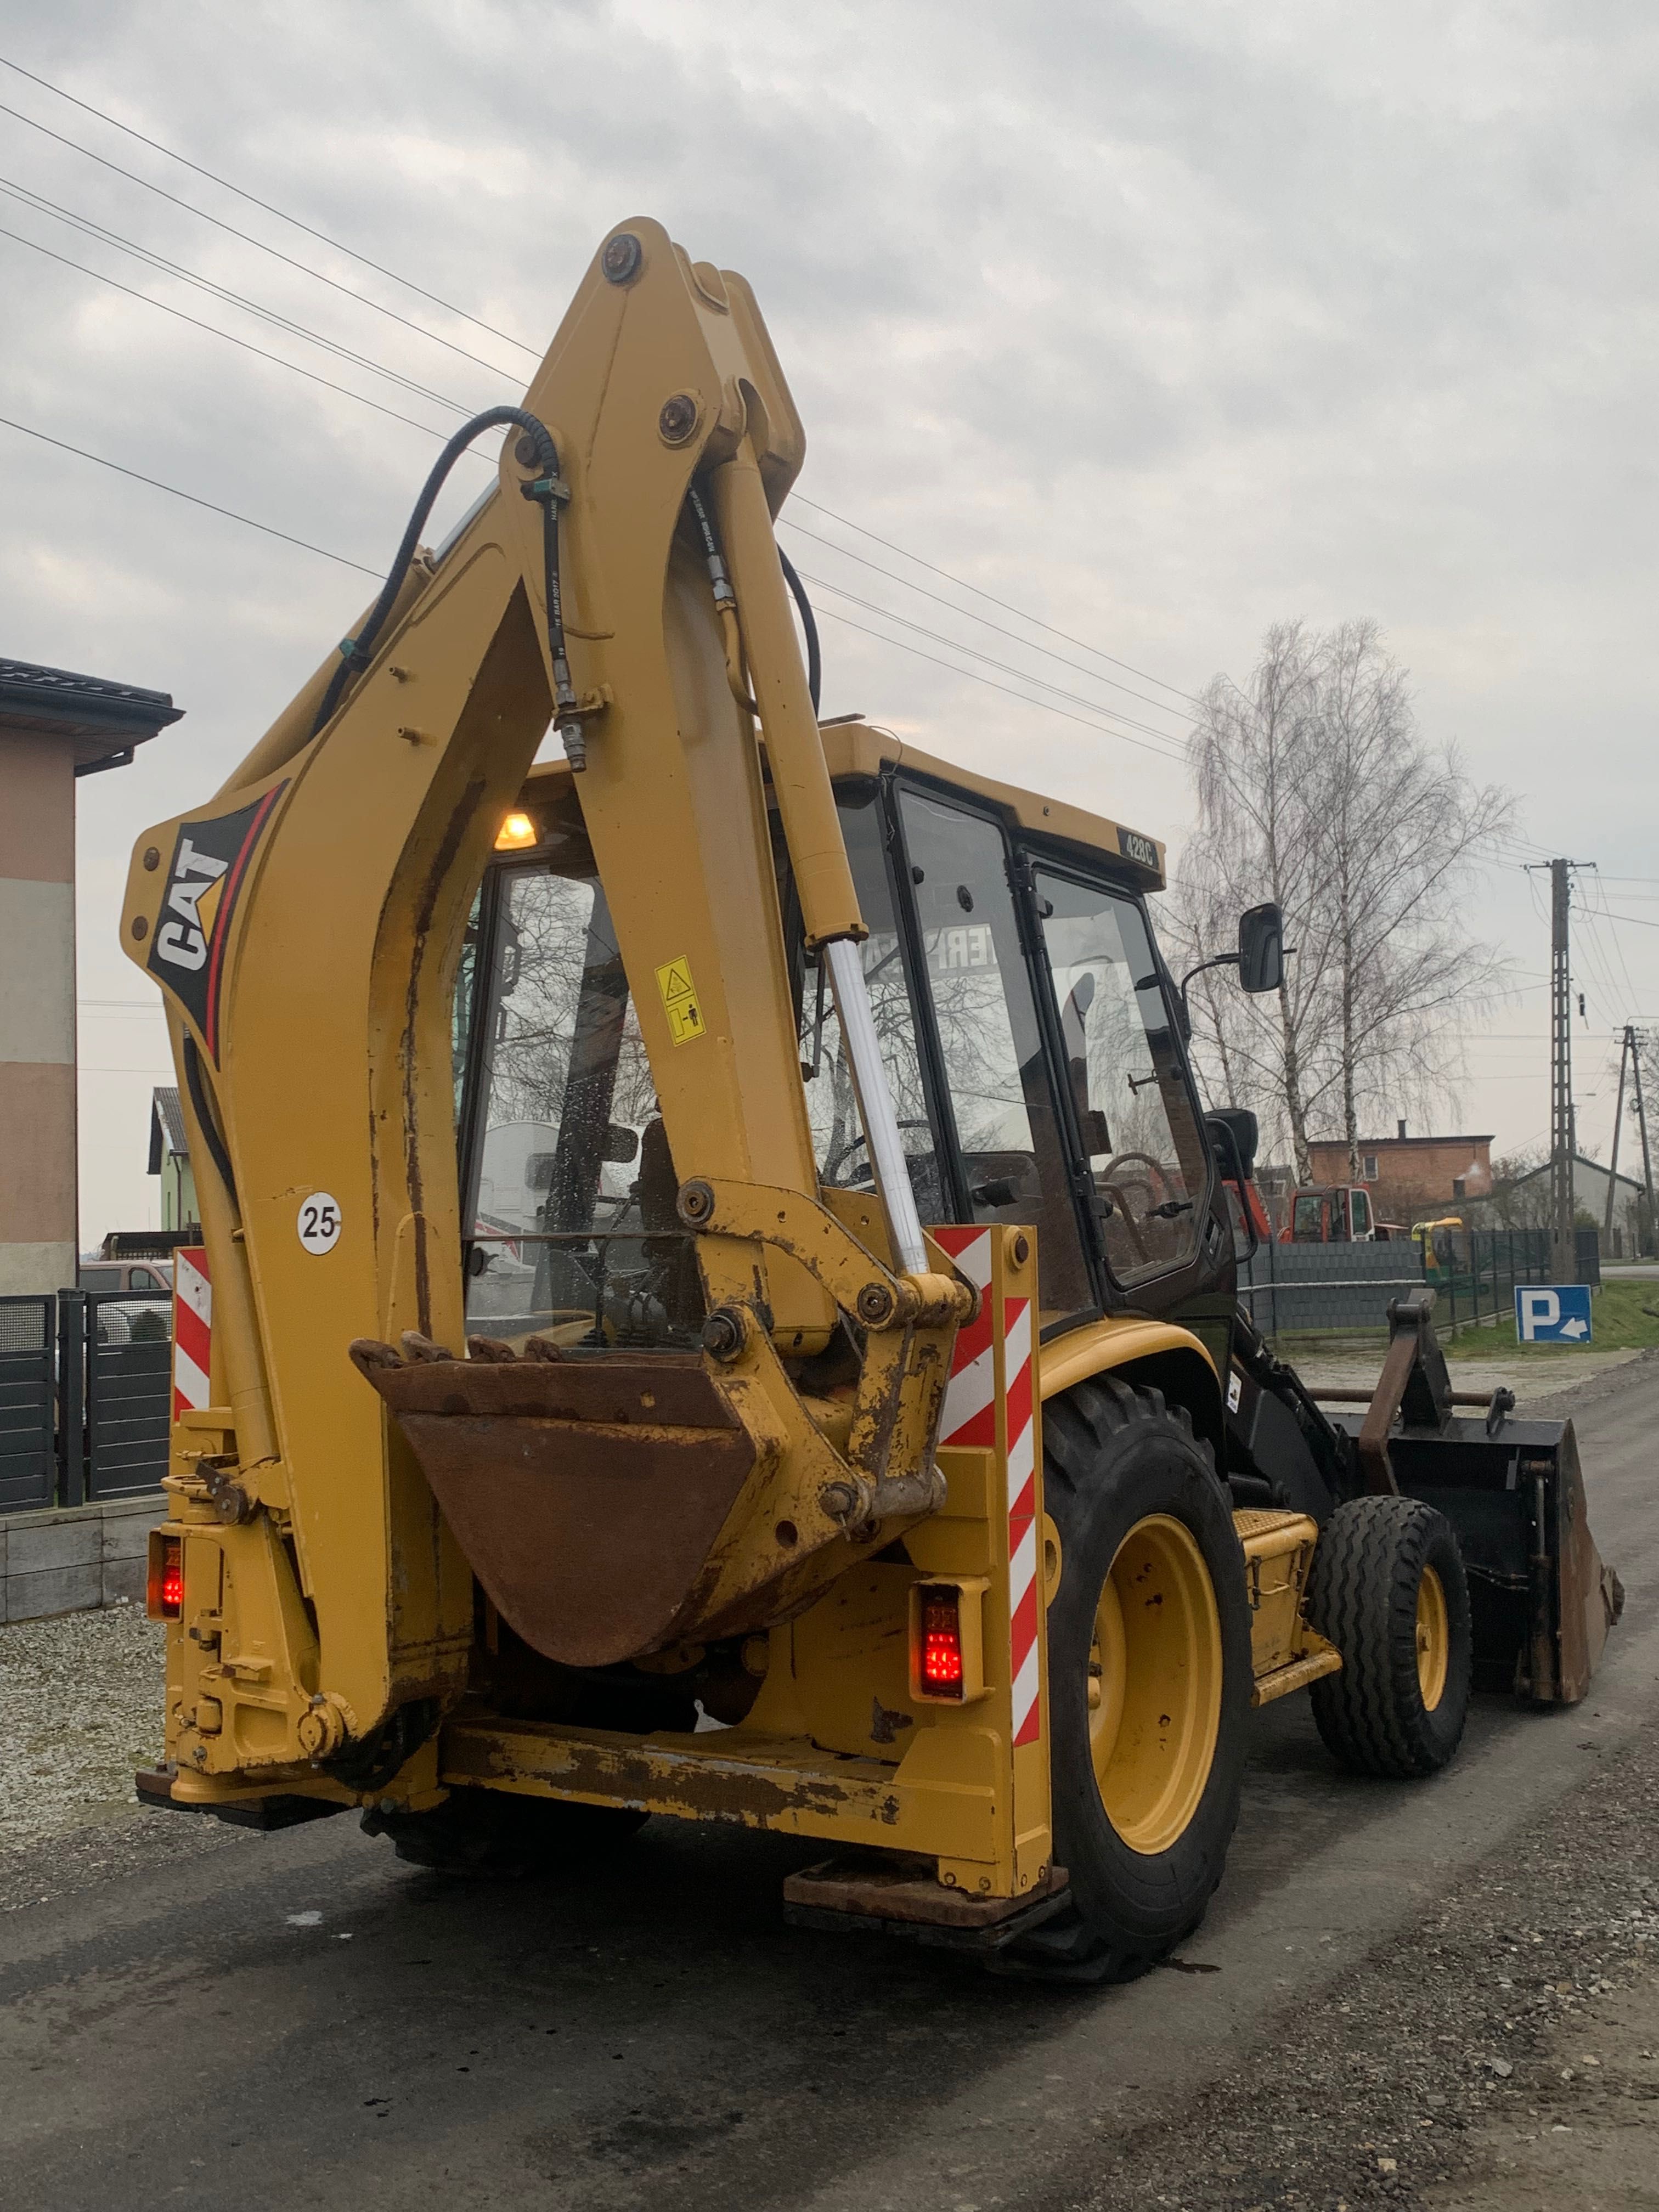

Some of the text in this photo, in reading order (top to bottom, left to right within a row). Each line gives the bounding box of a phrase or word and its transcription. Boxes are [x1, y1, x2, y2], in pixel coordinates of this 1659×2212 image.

[1126, 834, 1153, 866] 428C
[157, 838, 229, 970] CAT
[303, 1206, 335, 1238] 25
[1521, 1290, 1560, 1340] P
